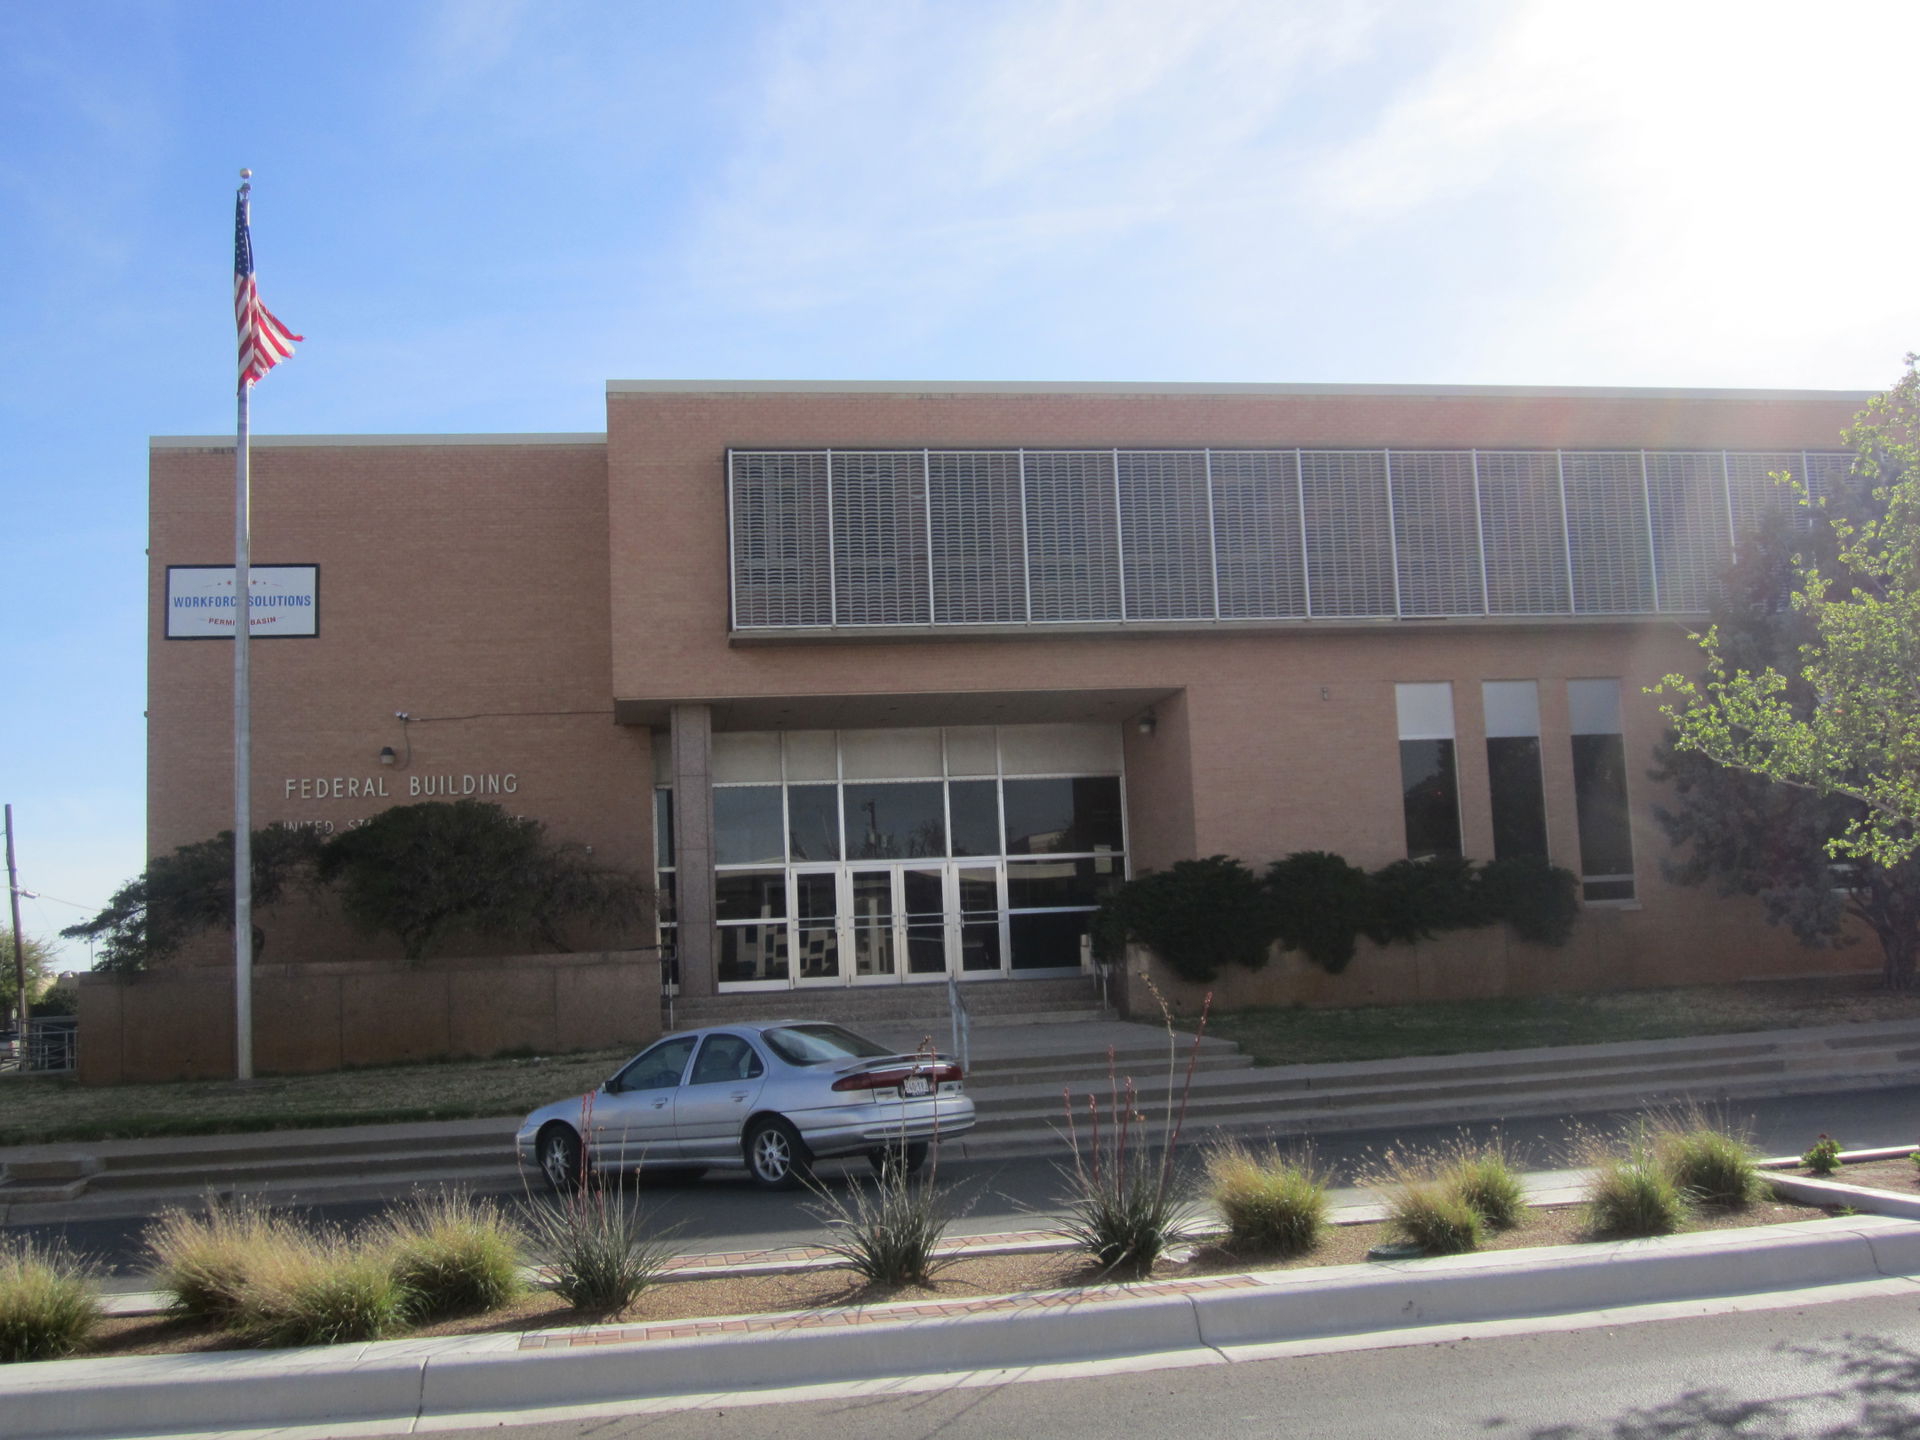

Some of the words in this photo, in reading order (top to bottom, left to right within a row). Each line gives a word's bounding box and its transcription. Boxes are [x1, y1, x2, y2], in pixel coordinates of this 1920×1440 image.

[174, 596, 236, 607] WORKFORC
[248, 595, 311, 607] SOLUTIONS
[208, 617, 235, 627] PERMI
[250, 616, 277, 626] BASIN
[285, 777, 389, 799] FEDERAL
[410, 773, 518, 796] BUILDING
